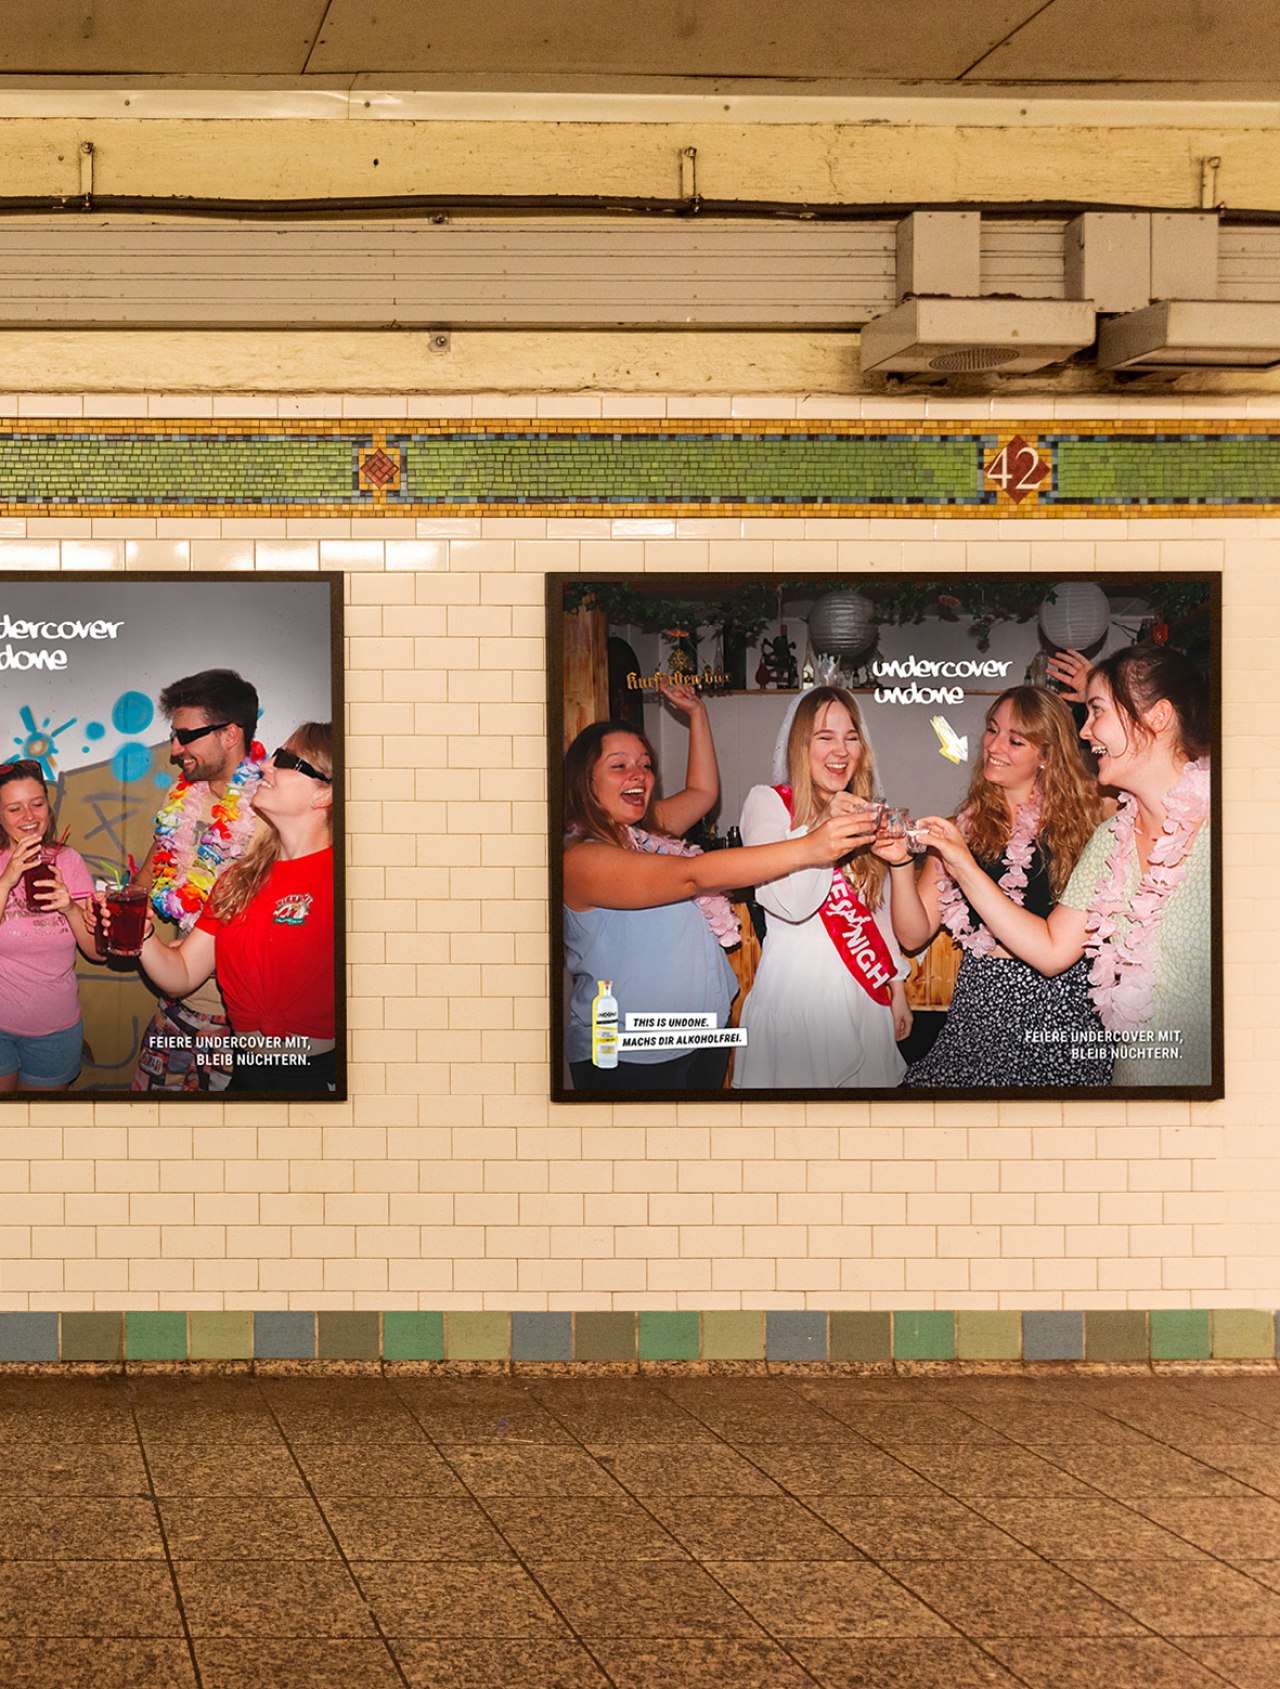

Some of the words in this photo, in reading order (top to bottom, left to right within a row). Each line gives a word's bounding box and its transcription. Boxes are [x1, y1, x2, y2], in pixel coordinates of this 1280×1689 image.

[987, 447, 1042, 490] 42
[872, 655, 1013, 678] undercover
[874, 682, 965, 705] undone
[633, 1017, 655, 1028] THIS
[656, 1017, 667, 1028] IS
[668, 1017, 709, 1028] UNDONE.
[149, 1036, 192, 1049] FEIERE
[196, 1036, 281, 1049] UNDERCOVER
[285, 1036, 311, 1051] MIT,
[622, 1037, 657, 1047] MACHS
[658, 1036, 675, 1046] DIR
[676, 1033, 742, 1045] ALKOHOLFREI.
[1024, 1030, 1068, 1043] FEIERE
[1071, 1030, 1154, 1042] UNDERCOVER
[1158, 1030, 1183, 1044] MIT,
[197, 1054, 233, 1066] BLEIB
[237, 1052, 311, 1066] NÜCHTERN.
[1071, 1048, 1107, 1060] BLEIB
[1110, 1045, 1183, 1060] NÜCHTERN.
